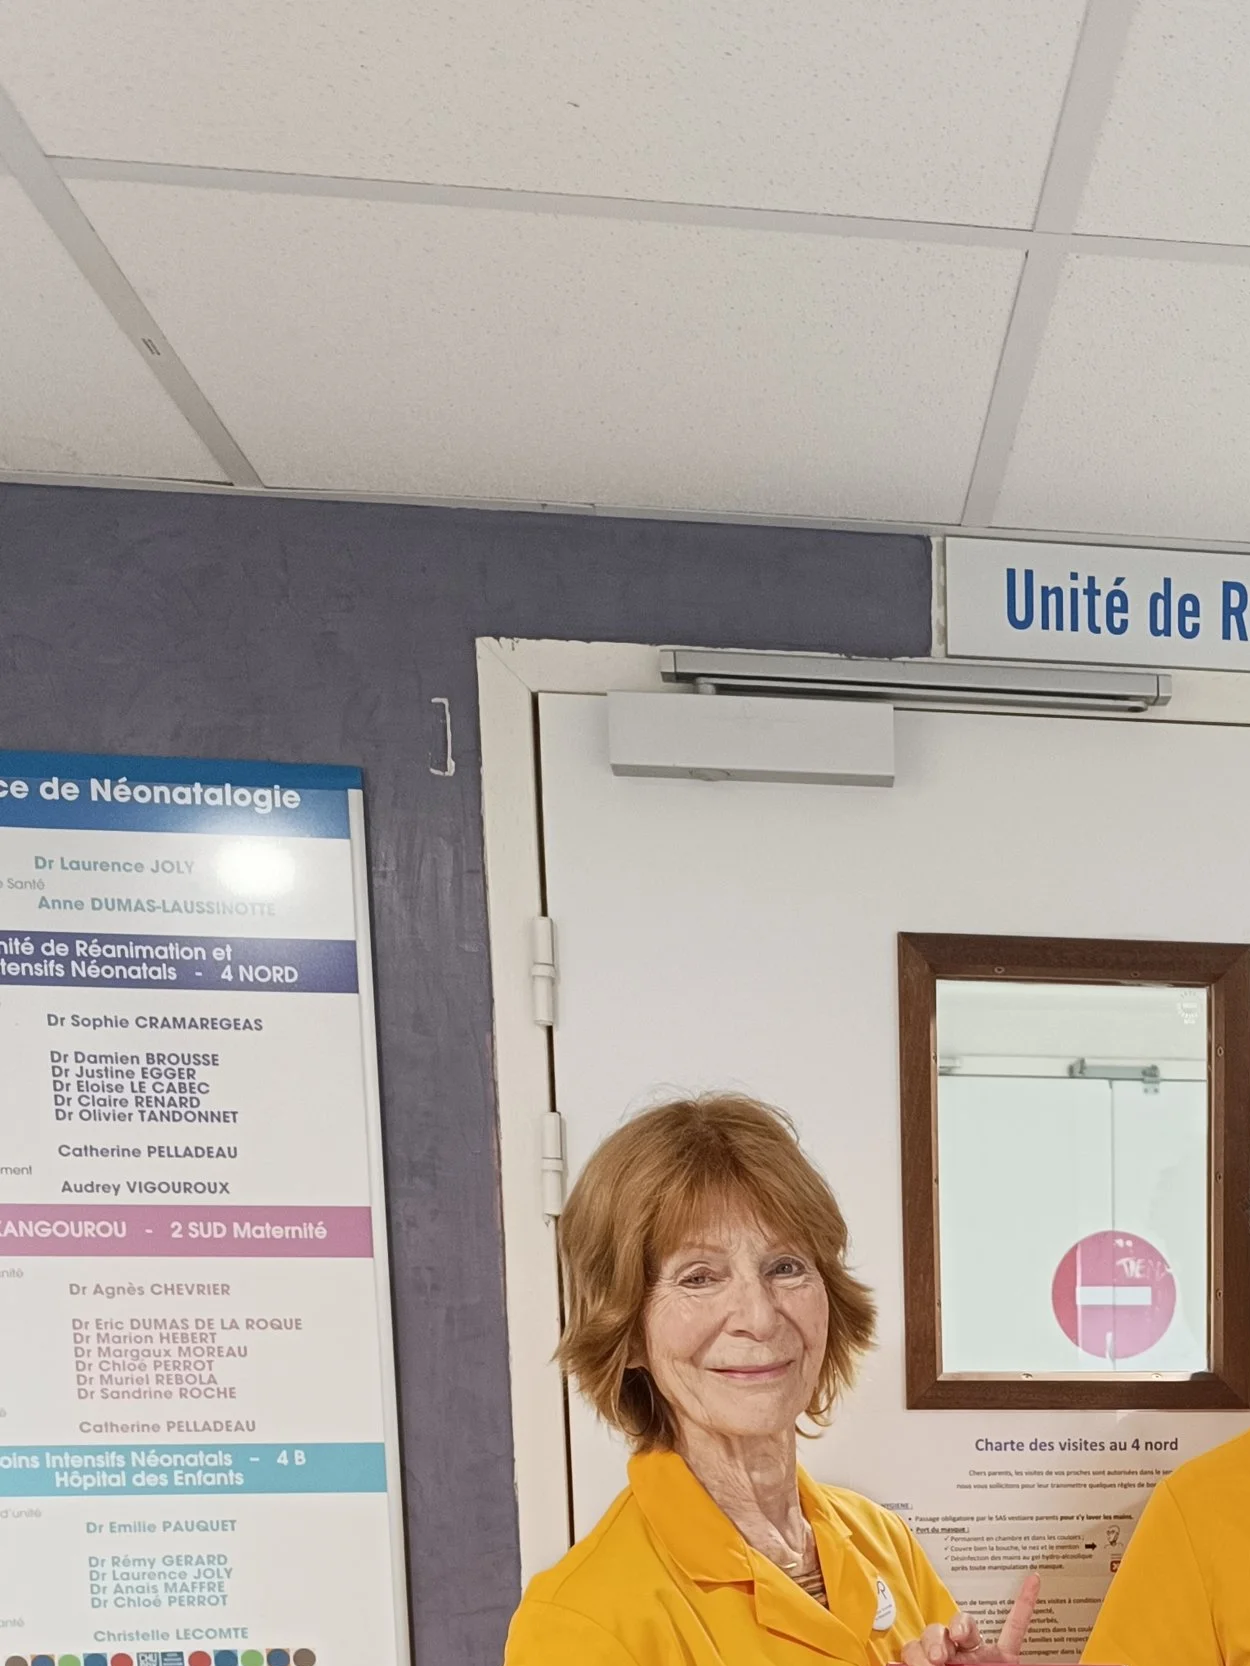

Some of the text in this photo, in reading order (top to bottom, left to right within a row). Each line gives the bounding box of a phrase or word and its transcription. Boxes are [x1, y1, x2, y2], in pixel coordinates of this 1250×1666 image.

[1006, 567, 1129, 635] Unité
[1149, 577, 1200, 638] de
[40, 776, 80, 801] de
[90, 776, 301, 813] Néonatalogie
[34, 855, 195, 875] Dr Laurence JOLY
[7, 877, 45, 891] Santé
[38, 896, 276, 917] Anne DUMAS-LAUSSINOTTE
[41, 938, 69, 956] de
[76, 938, 207, 961] Réanimation
[212, 944, 233, 961] et
[71, 959, 177, 981] Néonatals
[220, 965, 233, 981] 4
[239, 965, 298, 983] NORD
[47, 1014, 264, 1032] Dr Sophie CRAMAREGEAS
[50, 1050, 220, 1067] Dr Damien BROUSSE
[51, 1065, 197, 1081] Dr Justine EGGER
[52, 1080, 71, 1092] Dr
[130, 1081, 147, 1094] LE
[151, 1081, 210, 1095] CABEC
[53, 1094, 201, 1109] Dr Claire RENARD
[54, 1108, 239, 1124] Dr Olivier TANDONNET
[58, 1144, 238, 1159] Catherine PELLADEAU
[61, 1180, 230, 1196] Audrey VIGOUROUX
[170, 1221, 183, 1238] 2
[188, 1221, 227, 1239] SUD
[233, 1221, 328, 1240] Maternité
[69, 1281, 231, 1299] Dr Agnès CHEVRIER
[72, 1317, 303, 1331] Dr Eric DUMAS DE LA ROQUE
[73, 1331, 217, 1345] Dr Marion HEBERT
[74, 1345, 248, 1362] Dr Margaux MOREAU
[75, 1359, 215, 1373] Dr Chloé PERROT
[76, 1373, 218, 1386] Dr Muriel REBOLA
[77, 1387, 237, 1400] Dr Sandrine ROCHE
[79, 1420, 256, 1434] Catherine PELLADEAU
[975, 1437, 1179, 1452] Charte des visites au 4 nord
[45, 1451, 126, 1469] Intensifs
[131, 1450, 233, 1469] Néonatals
[276, 1450, 289, 1466] 4
[294, 1450, 307, 1466] B
[55, 1469, 245, 1491] Hôpital des Enfants
[85, 1519, 237, 1534] Dr Emilie PAUQUET
[88, 1554, 228, 1571] Dr Rémy GERARD
[89, 1567, 233, 1582] Dr Laurence JOLY
[90, 1583, 107, 1596] Dr
[164, 1581, 225, 1595] MAFFRE
[90, 1594, 229, 1610] Dr Chloé PERROT
[93, 1627, 249, 1643] Christelle LECOMTE
